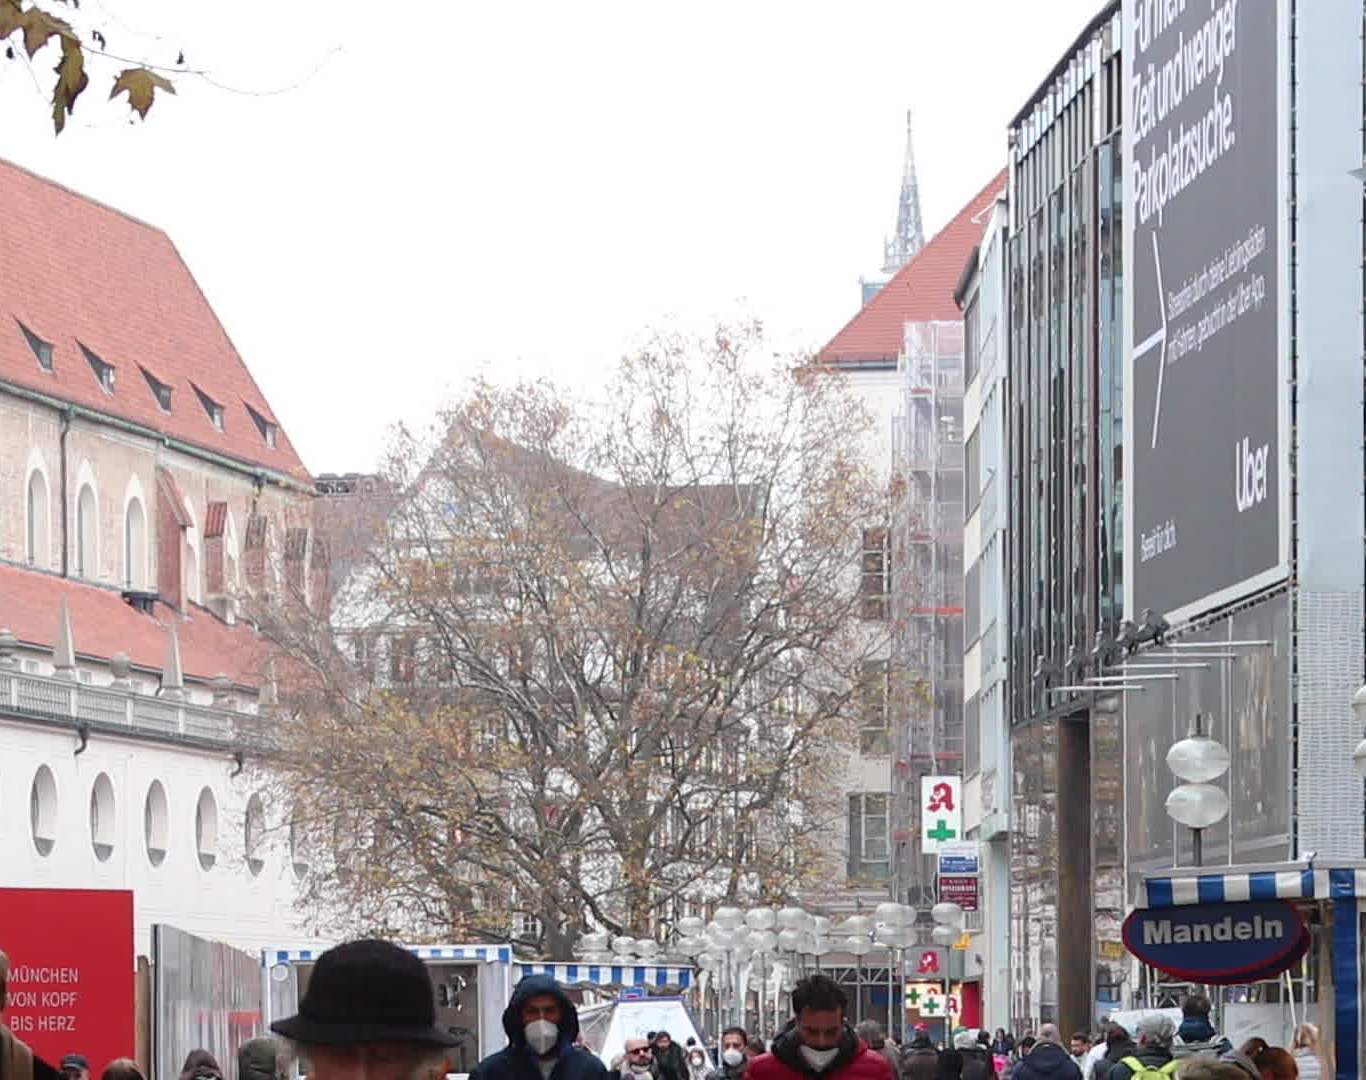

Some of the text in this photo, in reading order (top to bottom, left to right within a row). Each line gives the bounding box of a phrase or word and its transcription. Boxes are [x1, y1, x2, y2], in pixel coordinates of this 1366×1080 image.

[1133, 0, 1236, 145] Zeit und weniger
[1133, 85, 1236, 228] Parkplatzsuche.
[1235, 435, 1269, 513] Uber
[1142, 914, 1284, 946] Mandeln
[5, 964, 79, 984] MÜNCHEN
[6, 991, 79, 1008] VON KOPF
[10, 1015, 76, 1032] BIS HERZ
